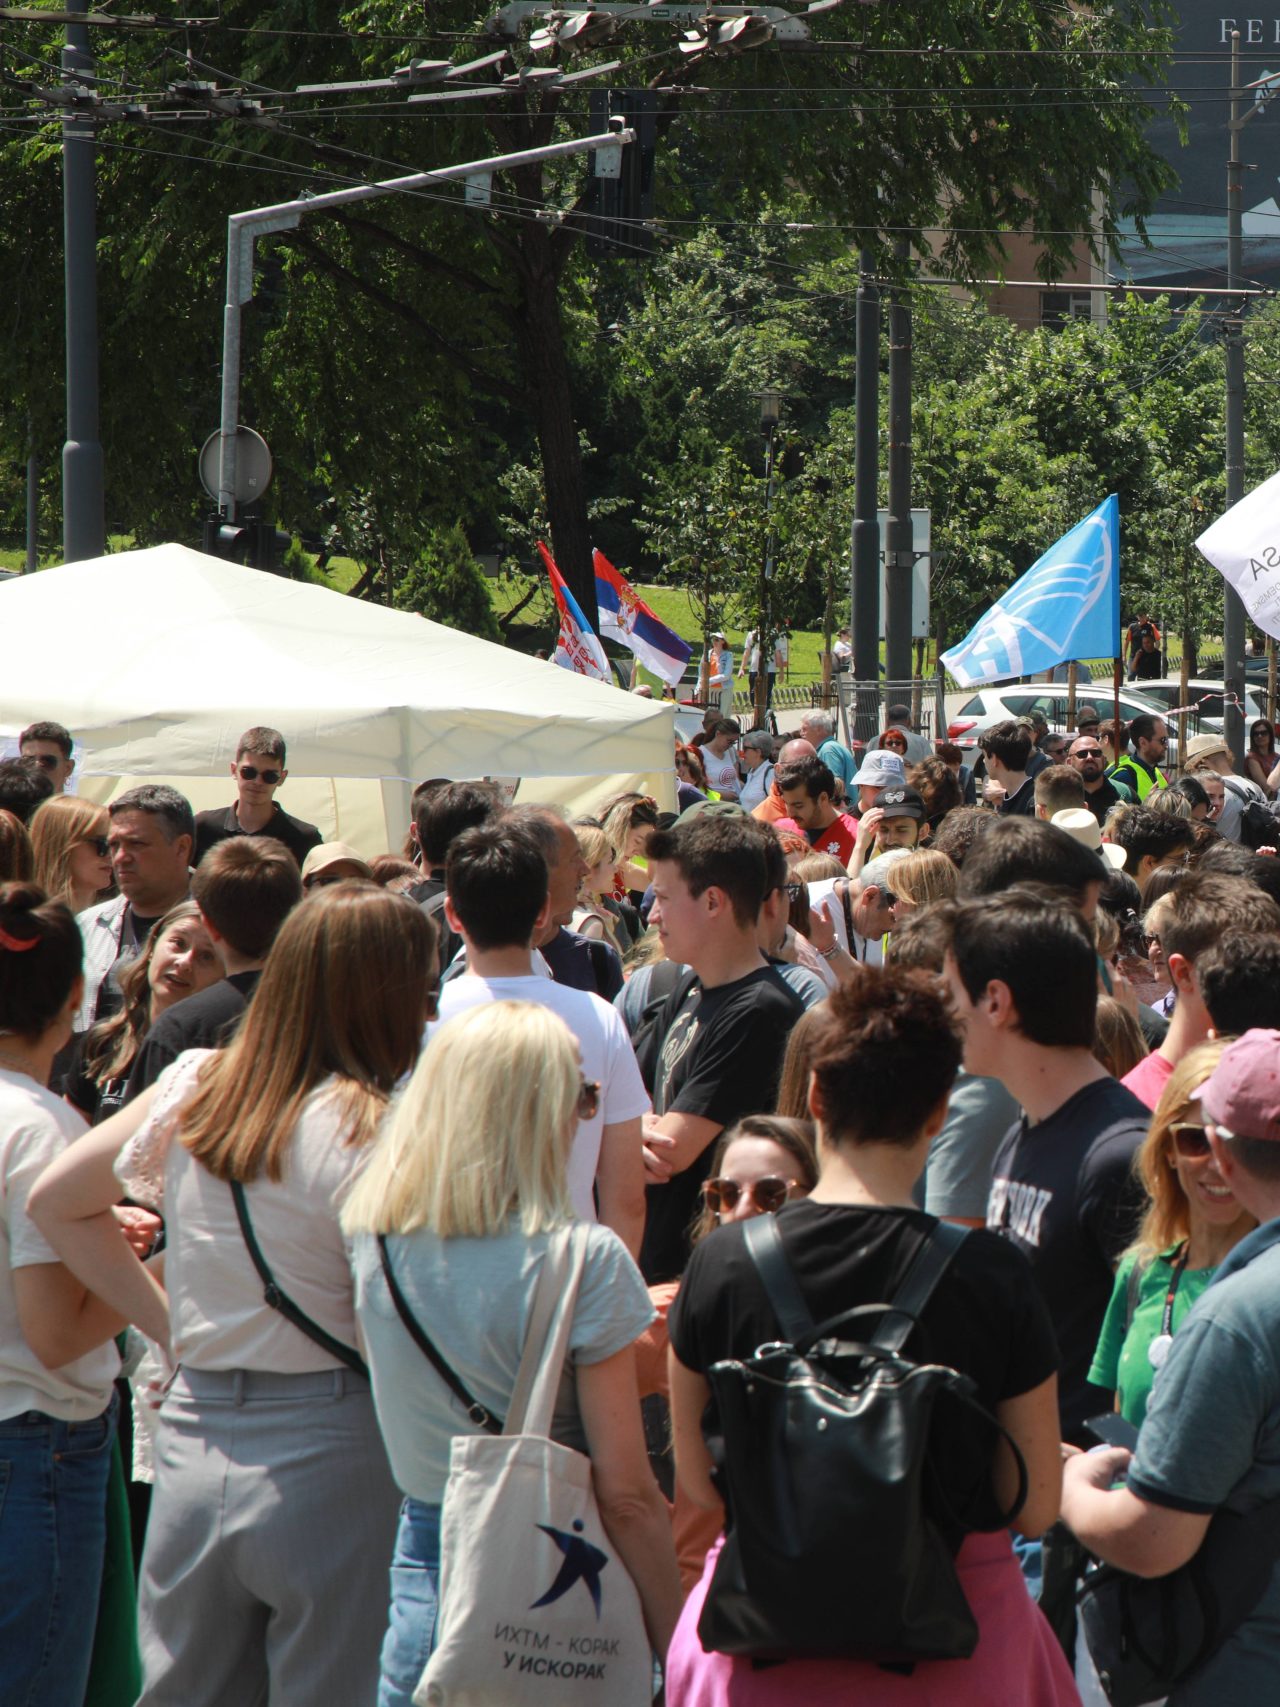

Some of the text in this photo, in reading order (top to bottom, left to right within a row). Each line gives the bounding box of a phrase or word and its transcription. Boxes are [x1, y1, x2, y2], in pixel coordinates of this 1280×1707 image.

[494, 1622, 550, 1651] ИХТМ
[568, 1637, 620, 1656] КОРАК
[503, 1650, 606, 1680] У ИСКОРАК
